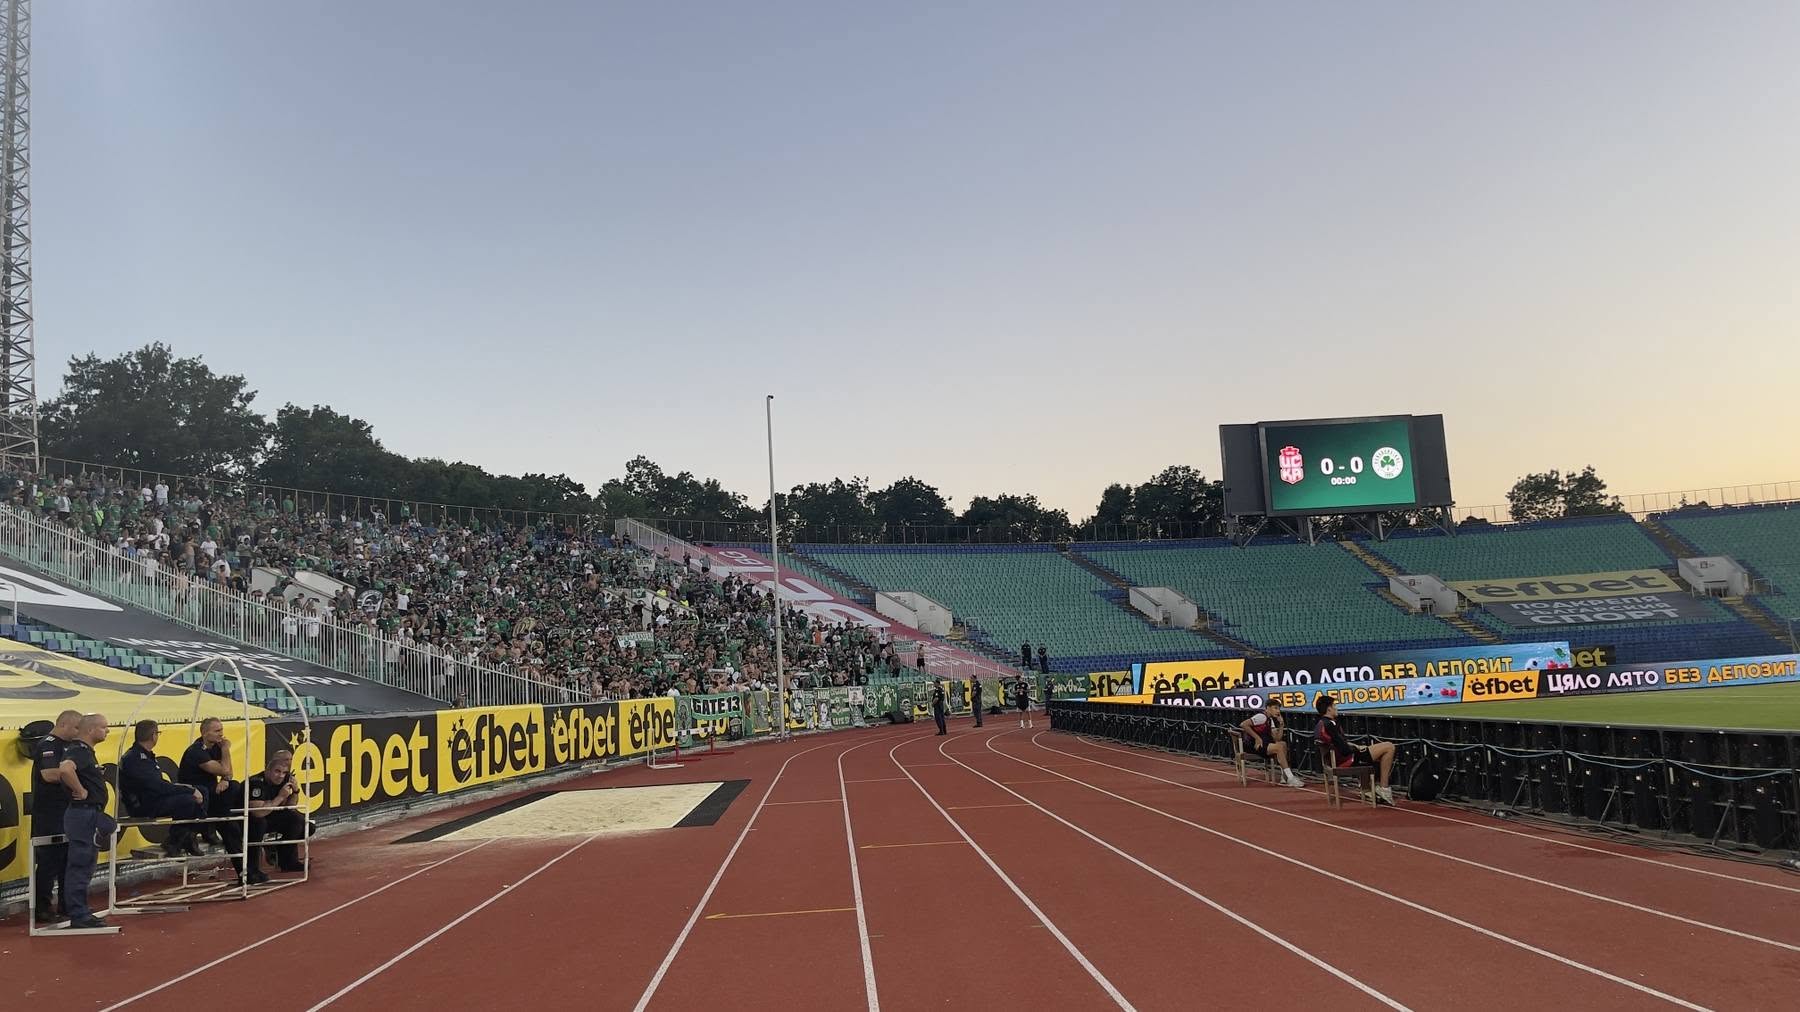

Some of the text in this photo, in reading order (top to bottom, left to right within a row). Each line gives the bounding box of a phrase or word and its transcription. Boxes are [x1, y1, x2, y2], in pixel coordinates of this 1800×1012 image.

[1321, 458, 1334, 475] 0
[1350, 456, 1363, 473] 0
[1331, 477, 1356, 485] 00:00
[1474, 575, 1667, 597] efbet
[1511, 595, 1661, 610] ПОДКРЕПЯ
[1519, 602, 1671, 616] БЪЛГАРСКИЯ
[1530, 608, 1680, 624] СПОРТ
[1471, 676, 1535, 696] efbet
[1547, 673, 1600, 693] ЦЯЛО
[1607, 670, 1659, 687] ЛЯТО
[1664, 668, 1701, 684] БЕЗ
[1707, 660, 1797, 683] ДЕПОЗИТ
[692, 696, 741, 715] GATE 13
[553, 707, 617, 764] efbet
[451, 711, 539, 783] efbet
[291, 721, 430, 814] efbet
